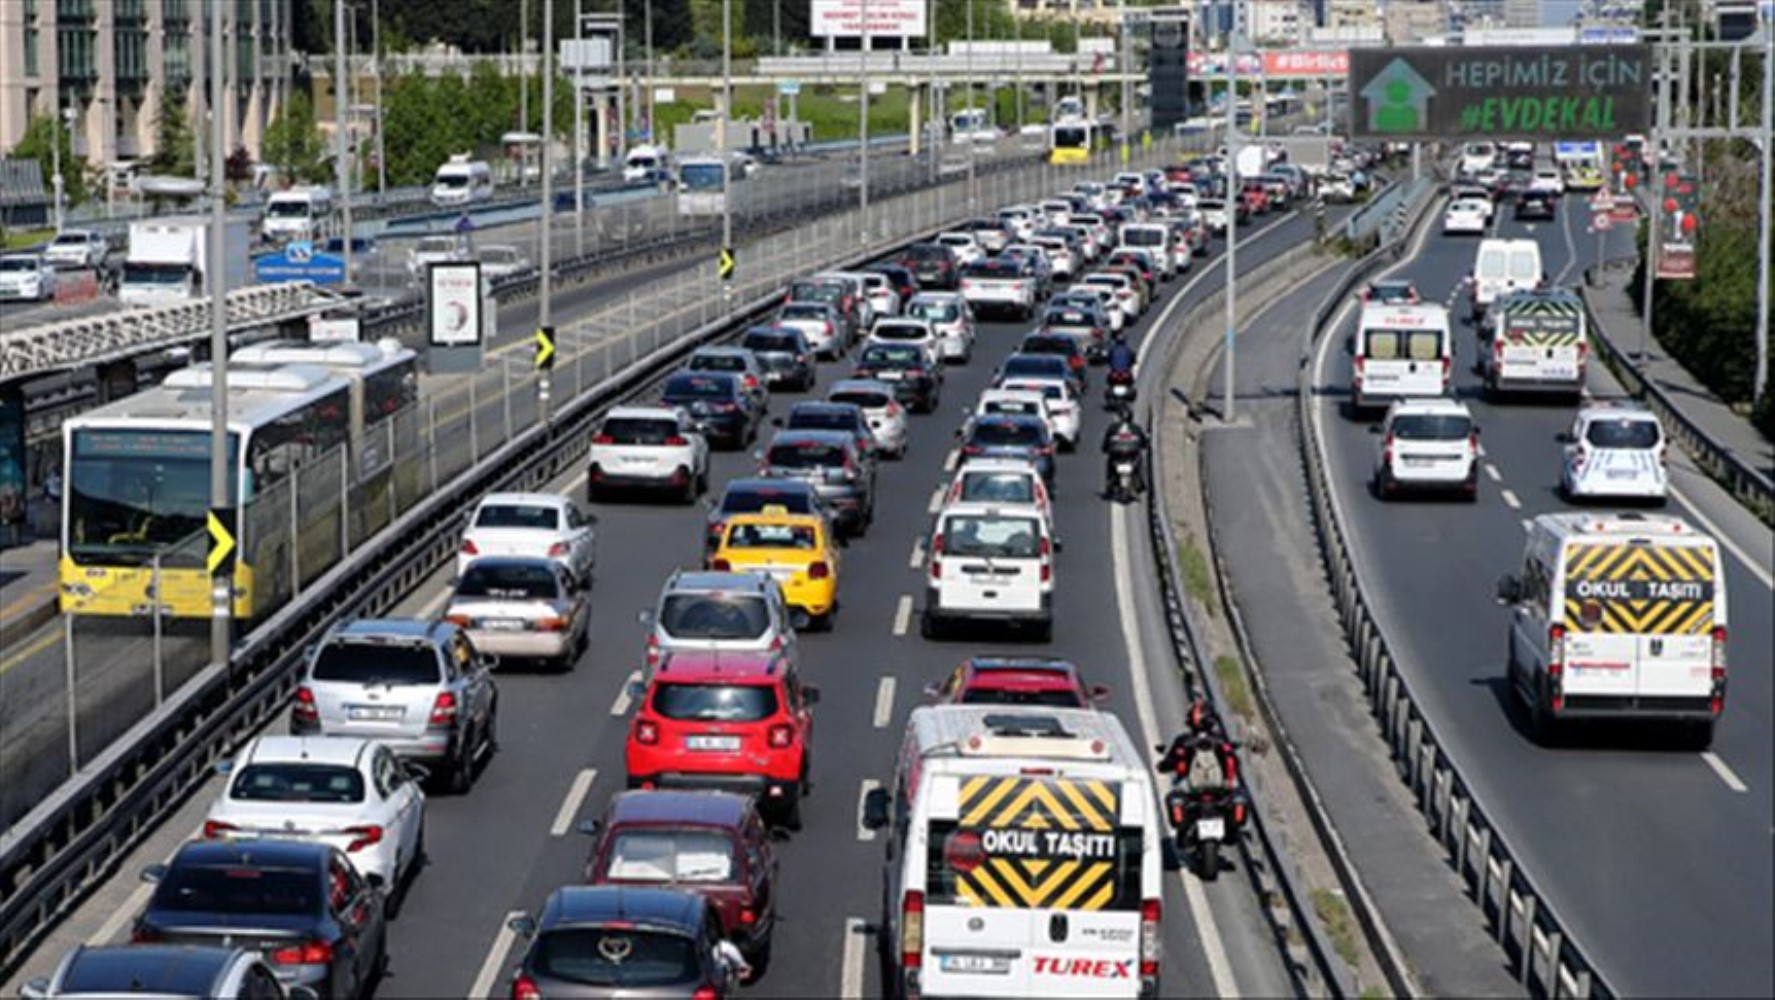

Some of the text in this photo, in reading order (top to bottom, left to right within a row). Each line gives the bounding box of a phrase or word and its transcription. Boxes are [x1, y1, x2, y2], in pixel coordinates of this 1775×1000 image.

[1445, 53, 1642, 91] HEPİMİZ İÇİN
[1460, 97, 1617, 132] #EVDEKAL
[1576, 581, 1631, 597] OKUL
[982, 830, 1115, 861] OKUL TAŞITI
[1034, 957, 1135, 979] TUREX
